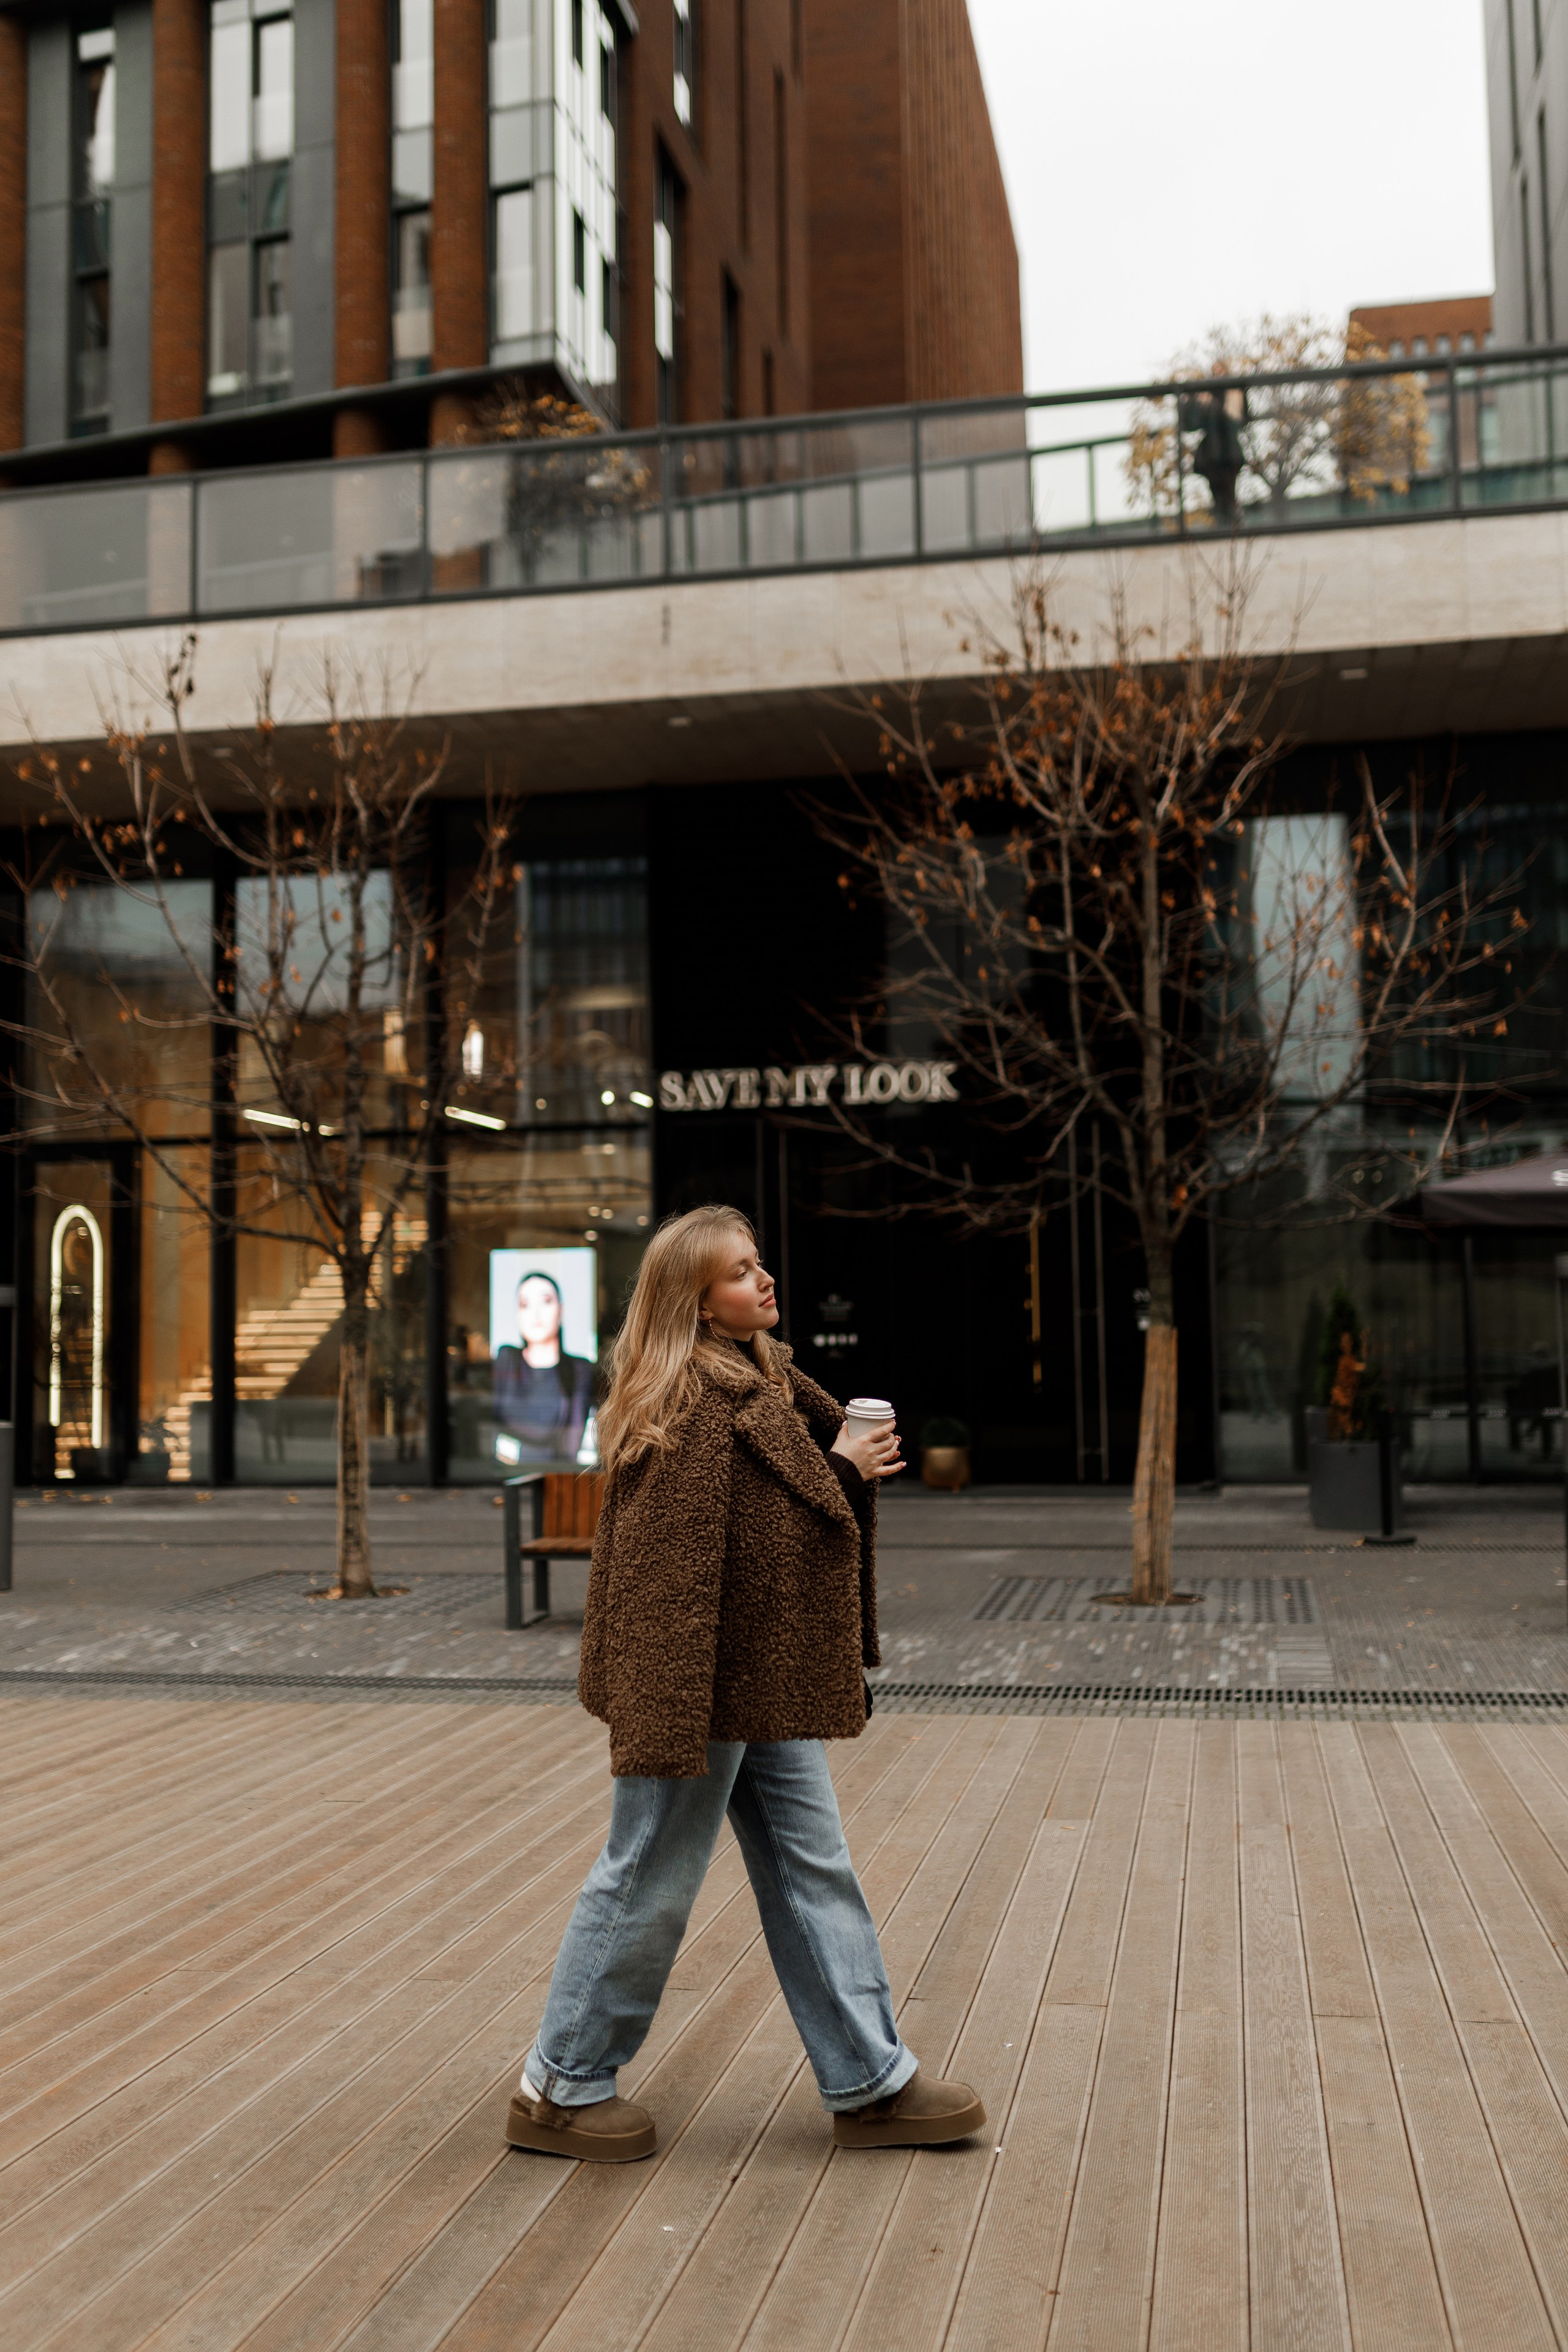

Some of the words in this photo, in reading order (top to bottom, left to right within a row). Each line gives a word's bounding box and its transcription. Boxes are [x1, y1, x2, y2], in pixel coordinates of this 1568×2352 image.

[660, 1068, 761, 1110] SAVE
[763, 1065, 837, 1107] MY
[842, 1061, 960, 1104] LOOK
